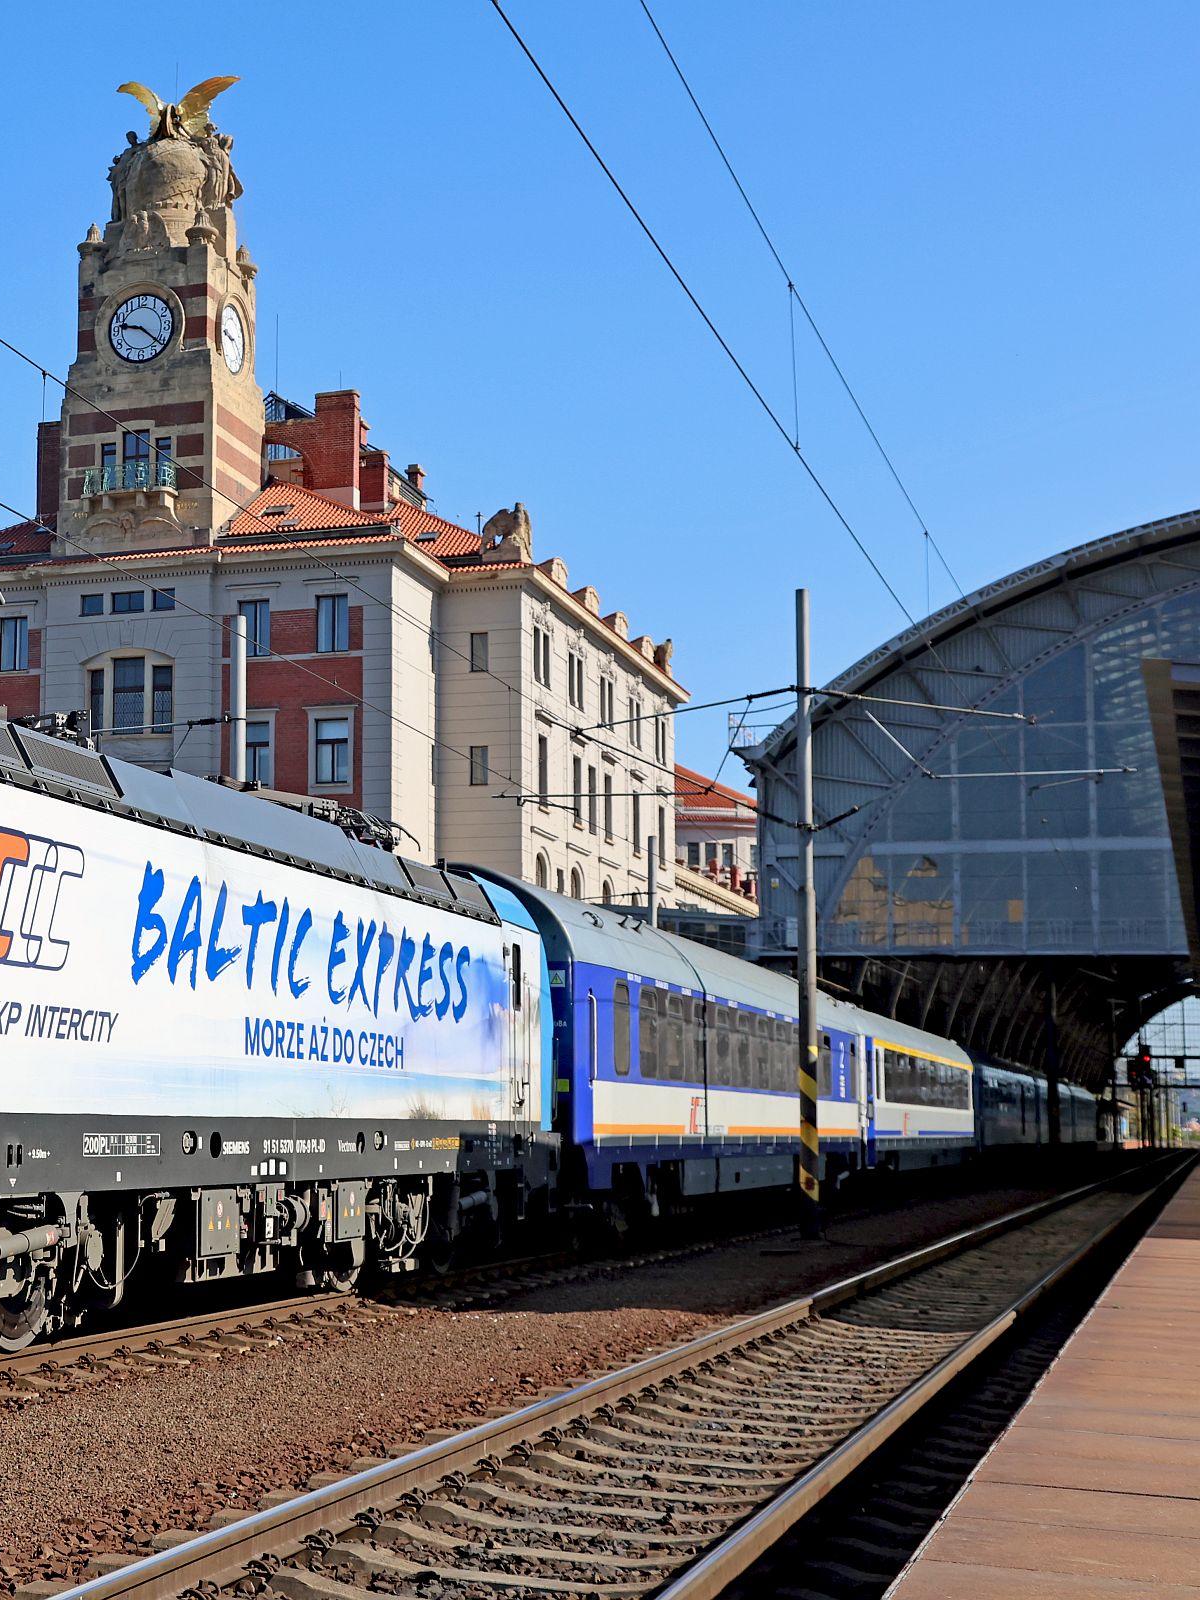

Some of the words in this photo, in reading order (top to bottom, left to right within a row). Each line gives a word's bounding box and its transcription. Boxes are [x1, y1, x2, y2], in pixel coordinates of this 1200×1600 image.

[125, 301, 133, 312] 11
[138, 296, 148, 307] 12
[115, 312, 125, 323] 10
[160, 306, 167, 318] 2
[163, 320, 170, 331] 3
[113, 326, 120, 337] 9
[116, 339, 123, 349] 8
[159, 334, 166, 344] 4
[126, 348, 132, 359] 7
[137, 349, 144, 360] 6
[150, 345, 157, 355] 5
[131, 861, 313, 999] BALTIC
[327, 910, 470, 1023] EXPRESS
[25, 1004, 119, 1043] INTERCITY
[245, 1016, 304, 1060] MORZE
[308, 1016, 329, 1062] AŻ
[333, 1027, 355, 1065] DO
[358, 1031, 404, 1070] CZECH
[84, 1136, 99, 1154] 200
[100, 1136, 111, 1154] PL
[222, 1140, 250, 1155] SIEMENS
[263, 1139, 271, 1154] 91
[271, 1139, 279, 1154] 51
[279, 1139, 294, 1154] 5370
[295, 1139, 311, 1154] 076-9
[311, 1138, 326, 1153] PL-ID
[337, 1139, 357, 1153] Vectron
